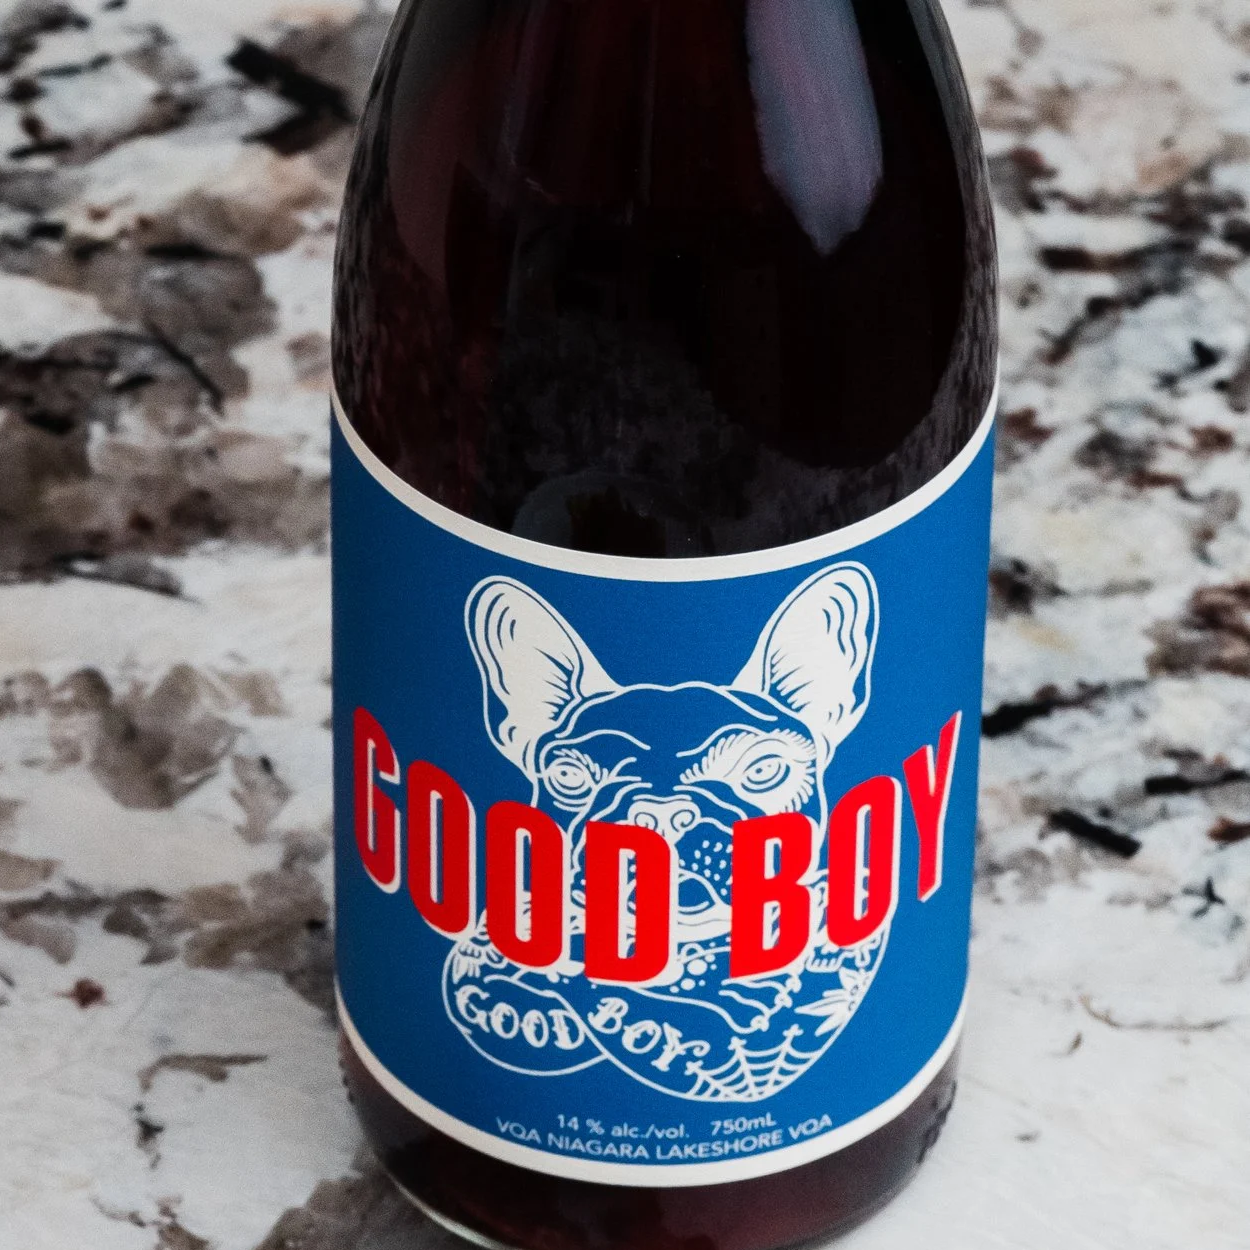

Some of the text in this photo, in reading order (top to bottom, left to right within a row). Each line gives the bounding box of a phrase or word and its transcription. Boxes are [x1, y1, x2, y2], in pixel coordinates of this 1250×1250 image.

[352, 705, 962, 987] GOOD BOY
[454, 983, 710, 1073] GOOD BOY
[495, 1114, 834, 1160] VQA NIAGARA LAKESHORE VQA
[556, 1113, 580, 1133] 14
[611, 1119, 690, 1141] alc./vol.
[710, 1111, 777, 1137] 750mL
